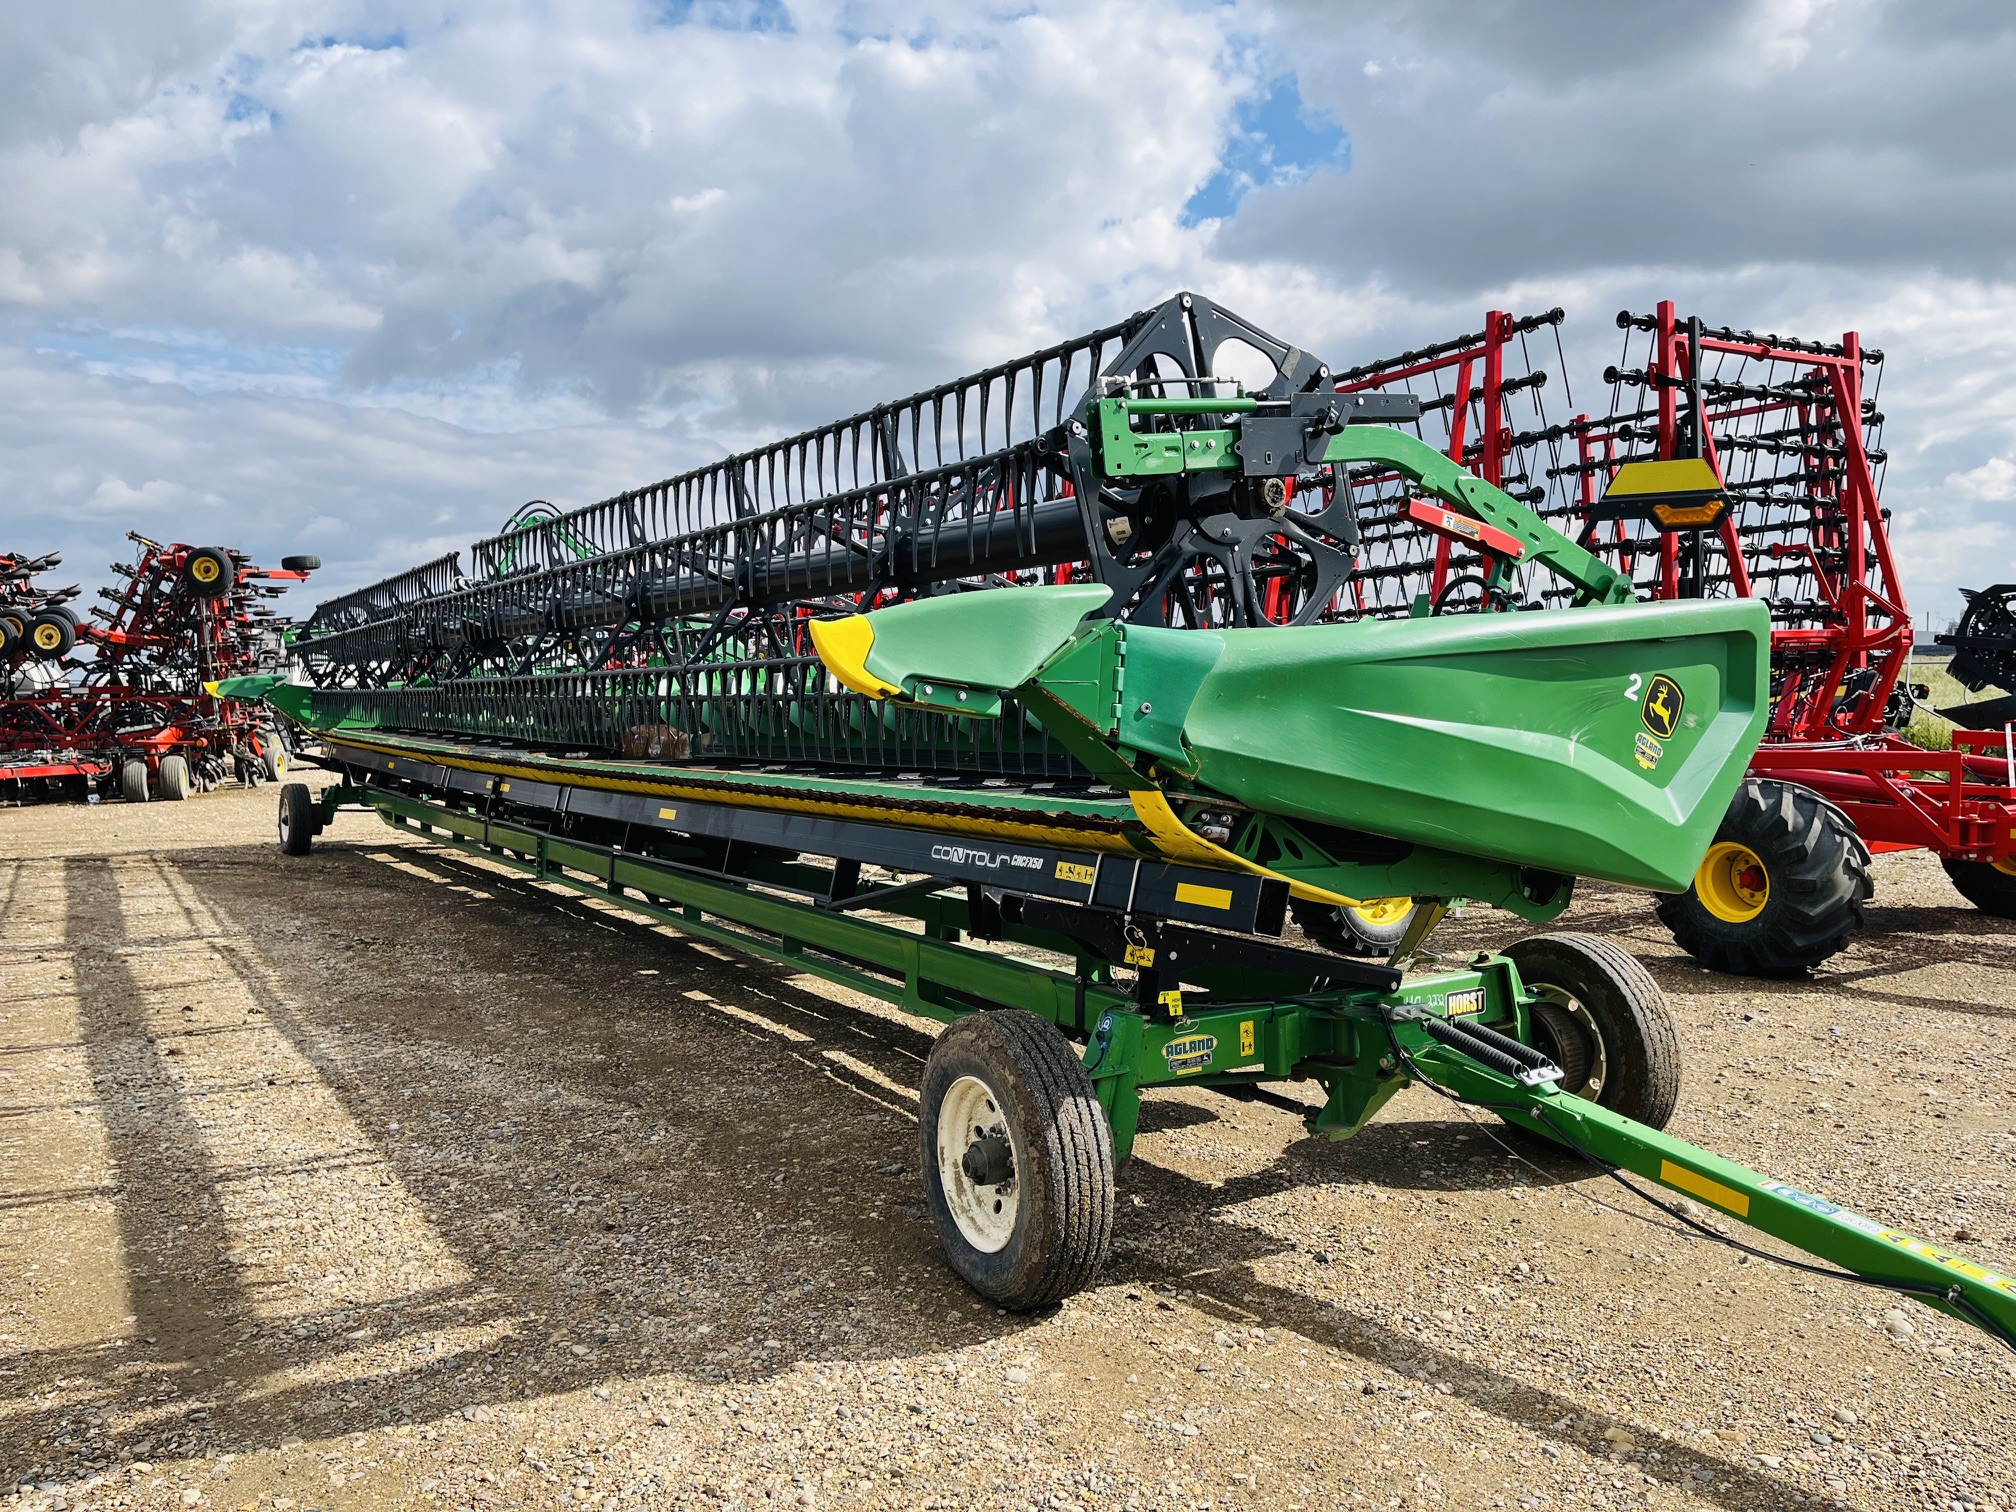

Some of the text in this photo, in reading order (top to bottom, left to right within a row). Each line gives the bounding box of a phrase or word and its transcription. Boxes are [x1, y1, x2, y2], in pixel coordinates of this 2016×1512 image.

[1624, 673, 1642, 701] 2
[1637, 733, 1662, 757] AGLAND
[1448, 990, 1484, 1016] HORST
[1165, 1037, 1214, 1058] AGLAND
